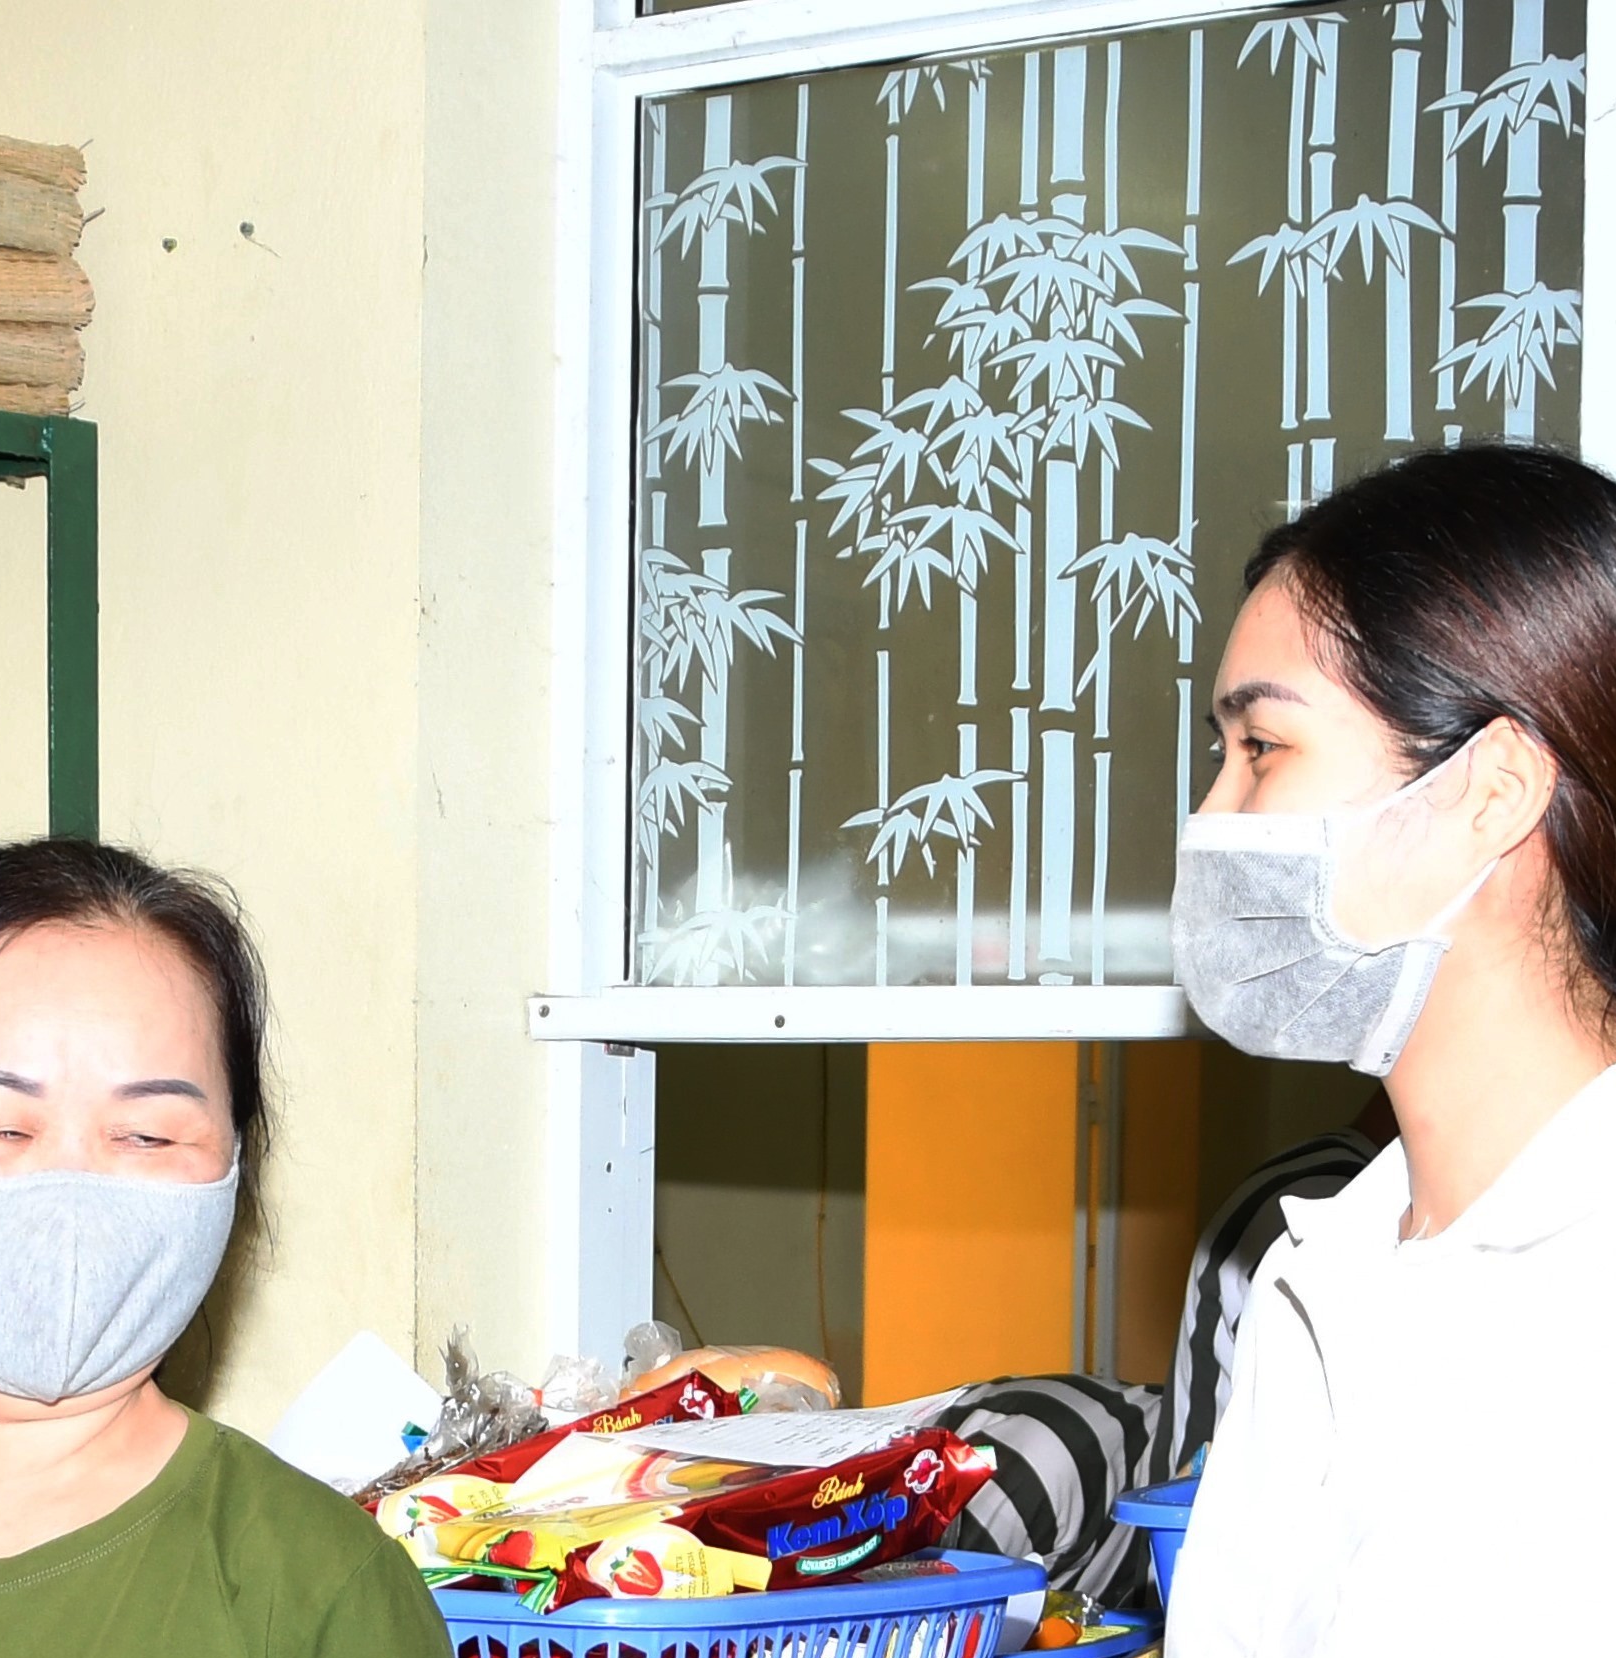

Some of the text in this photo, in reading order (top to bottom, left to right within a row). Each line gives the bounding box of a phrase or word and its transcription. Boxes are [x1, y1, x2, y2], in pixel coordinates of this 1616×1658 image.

[592, 1407, 642, 1435] Bánh
[812, 1472, 865, 1510] Bánh
[767, 1487, 909, 1561] Kem Xốp
